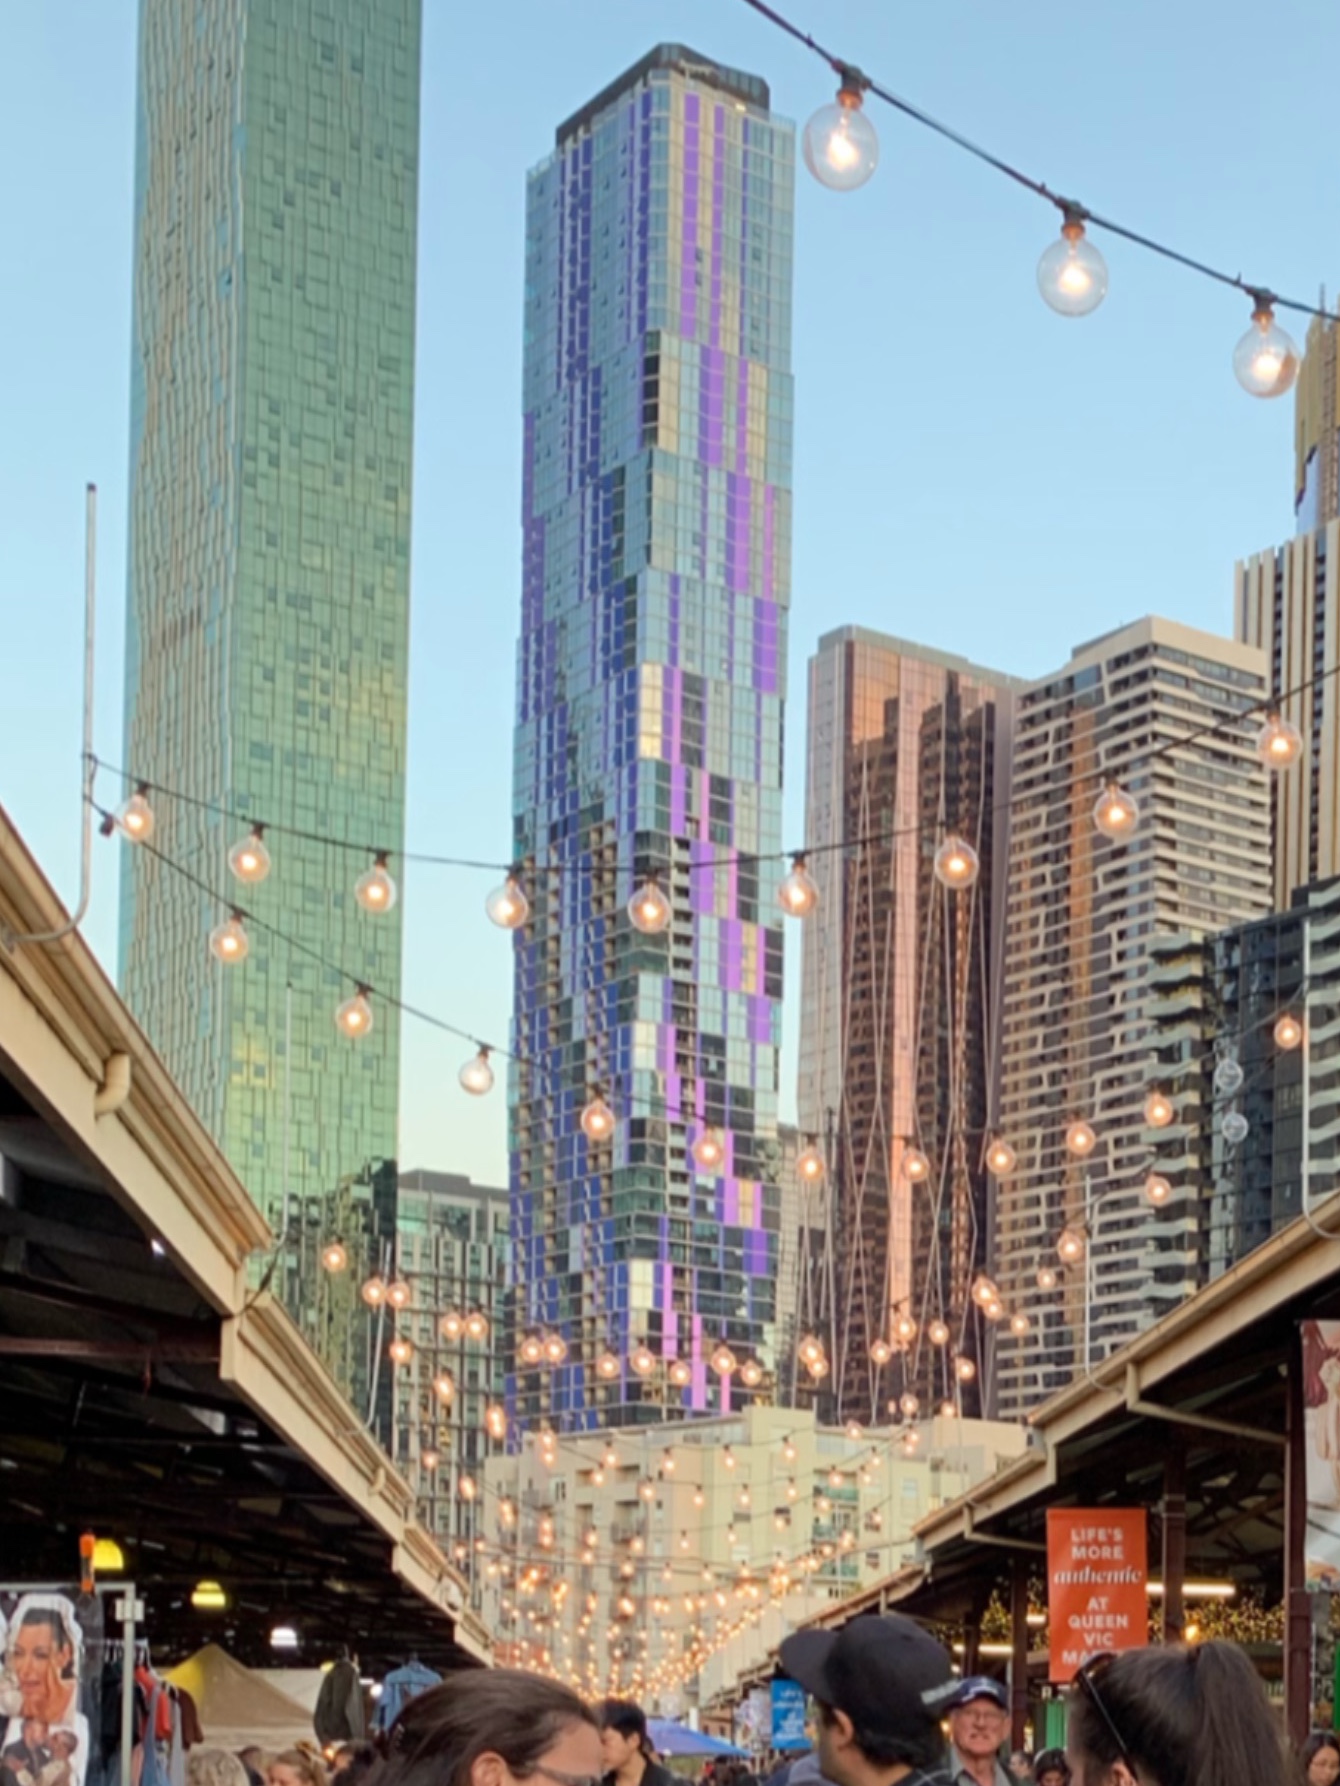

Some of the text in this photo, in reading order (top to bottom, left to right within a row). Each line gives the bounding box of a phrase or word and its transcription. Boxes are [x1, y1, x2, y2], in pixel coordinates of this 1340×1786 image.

[1070, 1527, 1124, 1542] LIFE'S
[1071, 1545, 1124, 1560] MORE
[1054, 1565, 1142, 1584] authentic
[1087, 1596, 1110, 1611] AT
[1068, 1614, 1129, 1629] QUEEN
[1084, 1632, 1114, 1647] VIC
